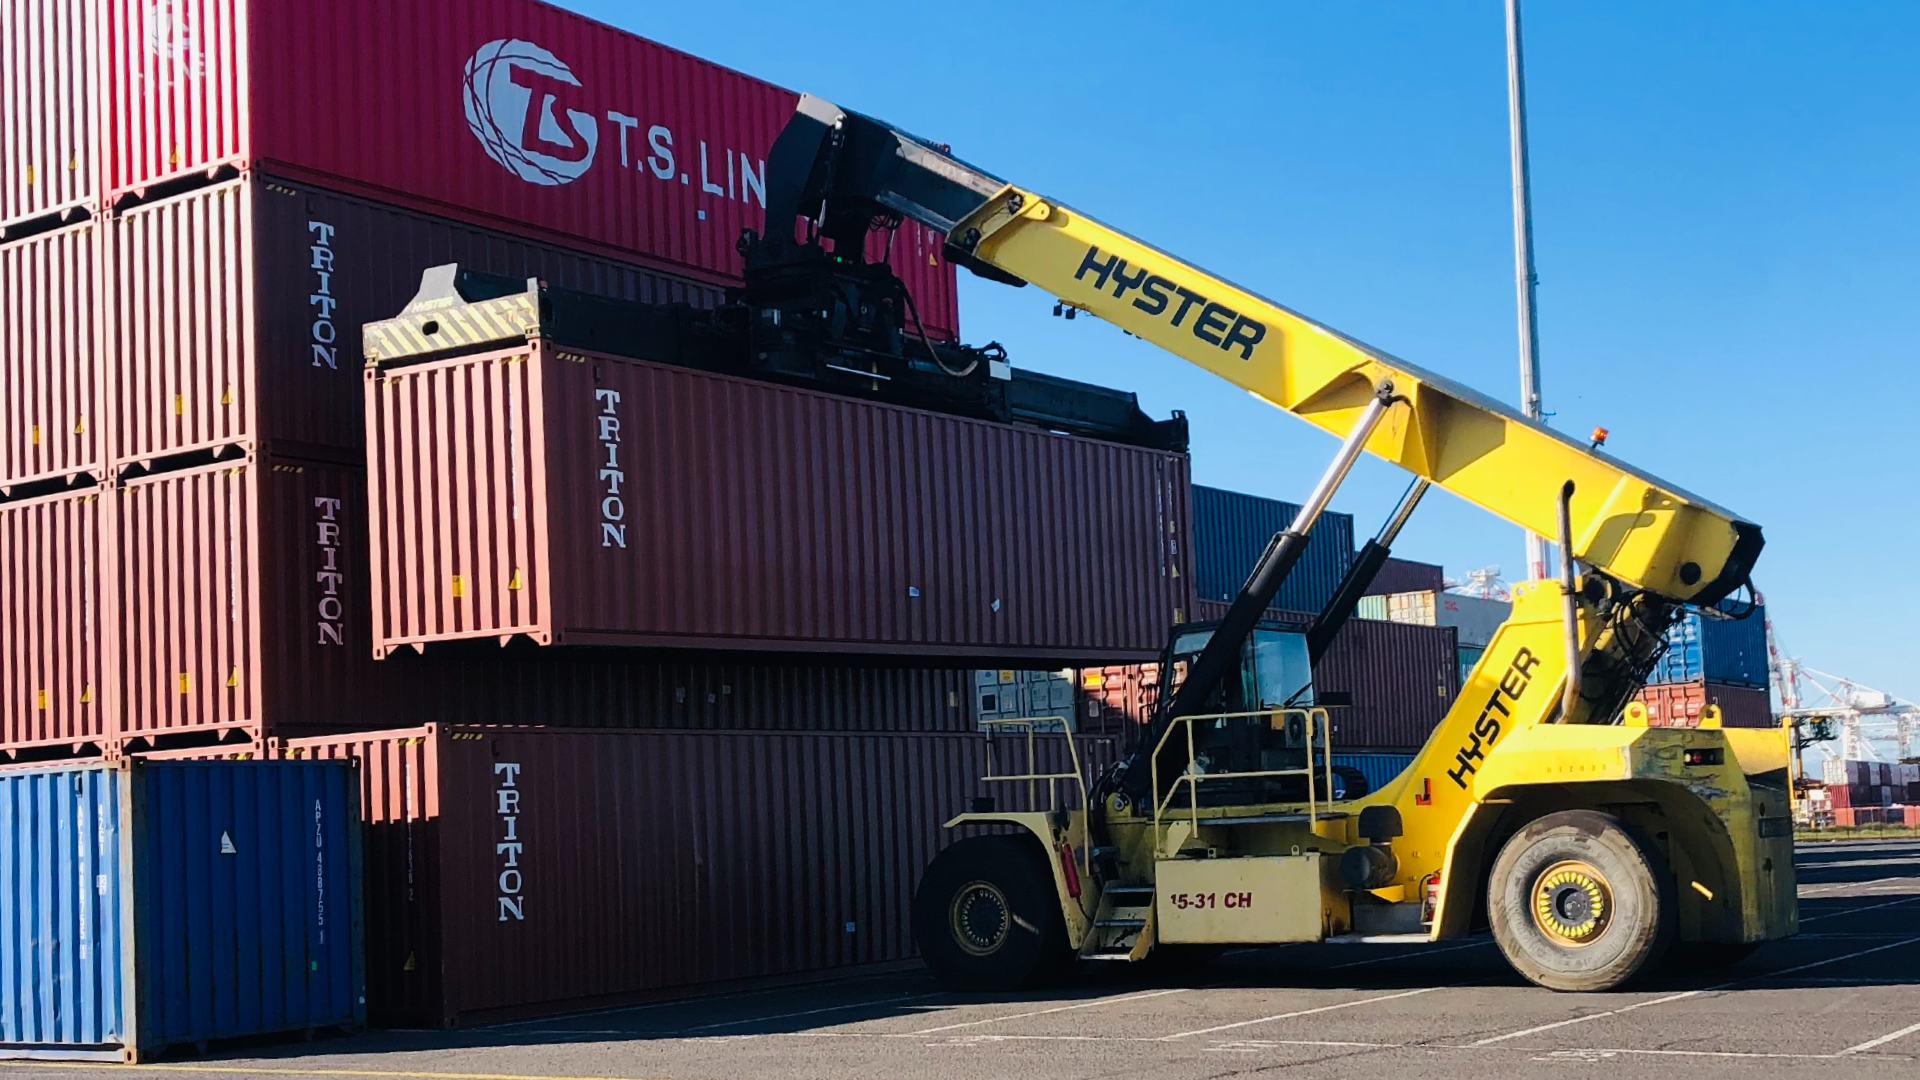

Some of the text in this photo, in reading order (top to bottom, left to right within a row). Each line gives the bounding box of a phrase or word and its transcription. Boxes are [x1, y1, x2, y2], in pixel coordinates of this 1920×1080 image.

[606, 109, 767, 209] T.S. LIN
[308, 220, 338, 369] TRITON
[1074, 246, 1267, 361] HYSTER
[595, 388, 627, 548] TRITON
[314, 496, 344, 645] TRITON
[1446, 646, 1541, 790] HYSTER
[315, 799, 323, 848] APZU
[494, 762, 524, 921] TRITON
[1224, 891, 1253, 909] CH
